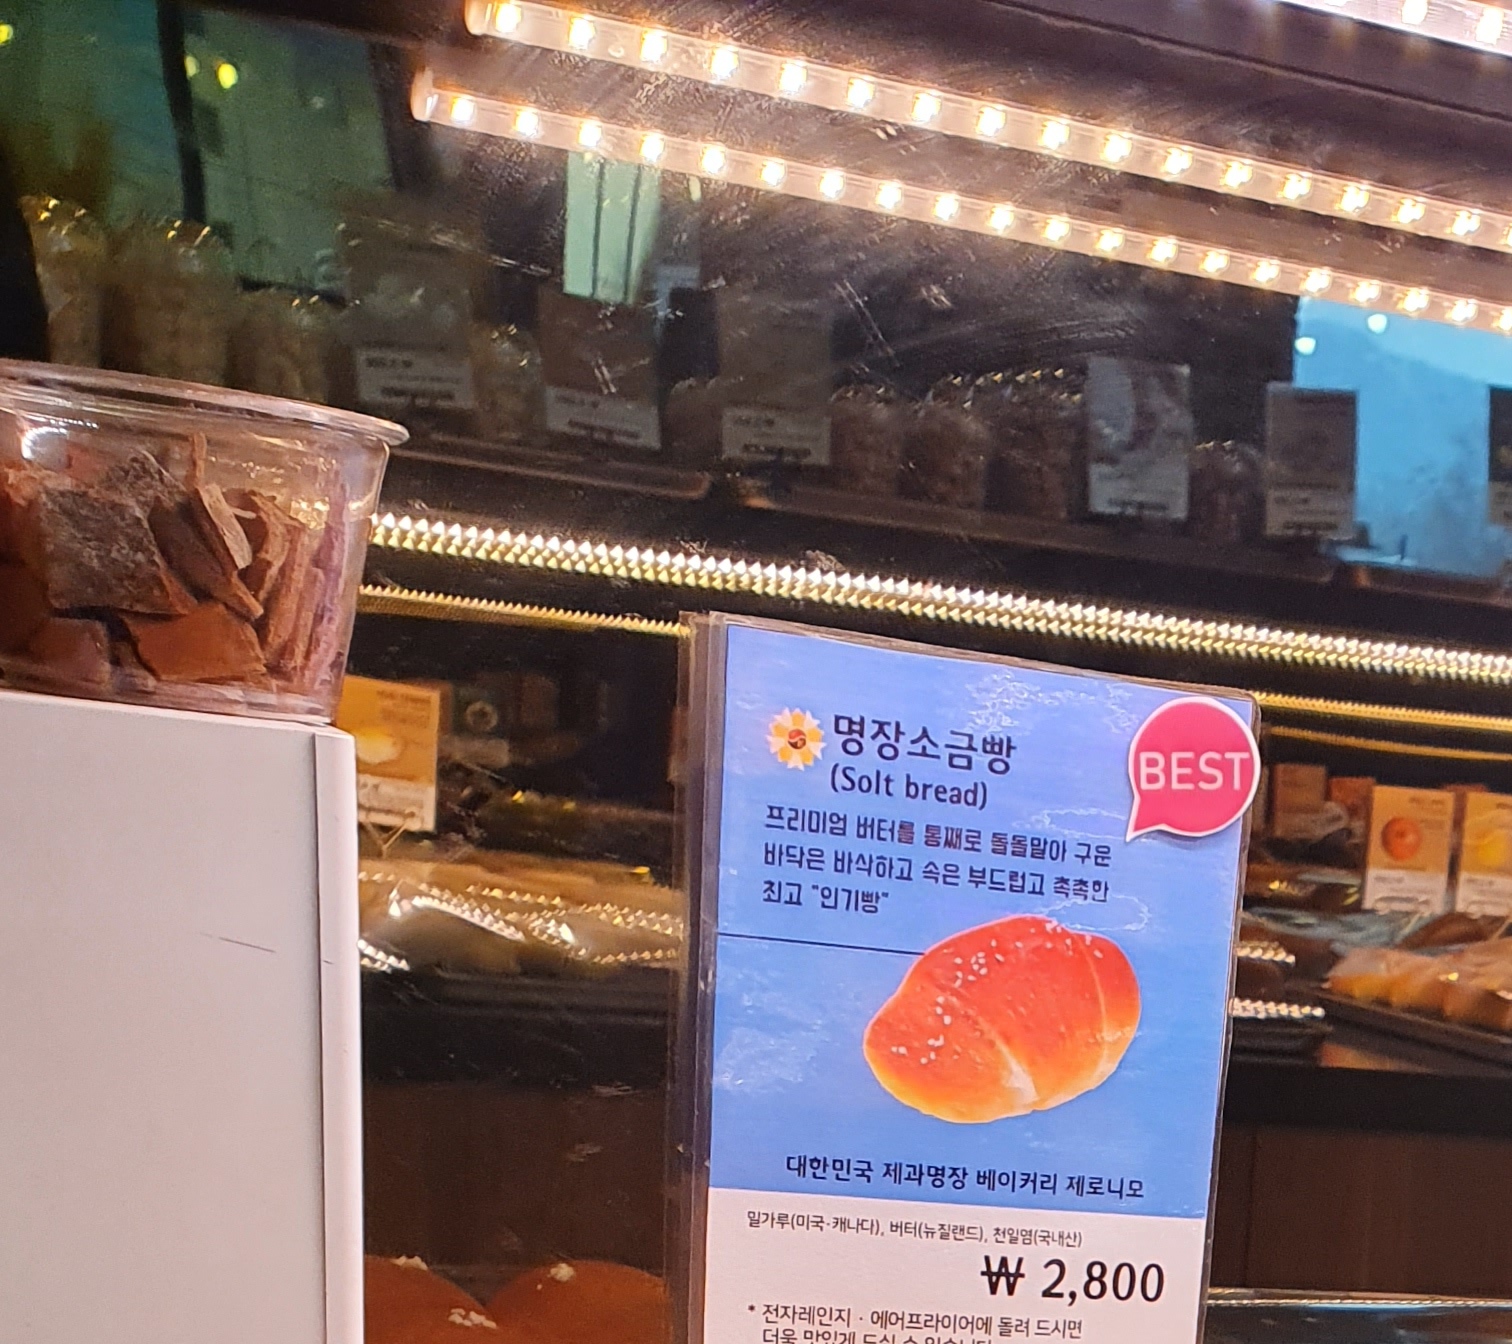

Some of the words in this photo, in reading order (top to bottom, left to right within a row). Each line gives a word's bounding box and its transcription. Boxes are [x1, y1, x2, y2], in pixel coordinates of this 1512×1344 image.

[833, 713, 1017, 776] 명장소금빵
[830, 762, 894, 798] (Solt
[905, 773, 988, 811] bread)
[1139, 750, 1251, 791] BEST
[764, 804, 847, 837] 프리미엄
[856, 815, 915, 845] 버터를
[923, 823, 982, 853] 통째로
[990, 831, 1068, 862] 돌돌말아
[1074, 842, 1112, 868] 구운
[764, 841, 825, 872] 바닥은
[833, 850, 913, 881] 바삭하고
[922, 860, 961, 887] 속은
[967, 865, 1045, 896] 부드럽고
[1053, 875, 1110, 903] 촉촉한
[762, 879, 803, 906] 최고
[811, 884, 889, 914] "인기빵"
[785, 1154, 874, 1184] 대한민국
[882, 1161, 969, 1190] 제과명장
[975, 1168, 1058, 1196] 베이커리
[1066, 1174, 1145, 1200] 제로니모
[993, 1226, 1082, 1248] 천일염(국내산)
[980, 1254, 1025, 1296] ₩
[1041, 1258, 1165, 1307] 2,800
[762, 1303, 851, 1328] 전자레인지
[870, 1309, 993, 1336] 에어프라이어에
[997, 1316, 1030, 1338] 돌려
[1034, 1318, 1082, 1339] 드시면
